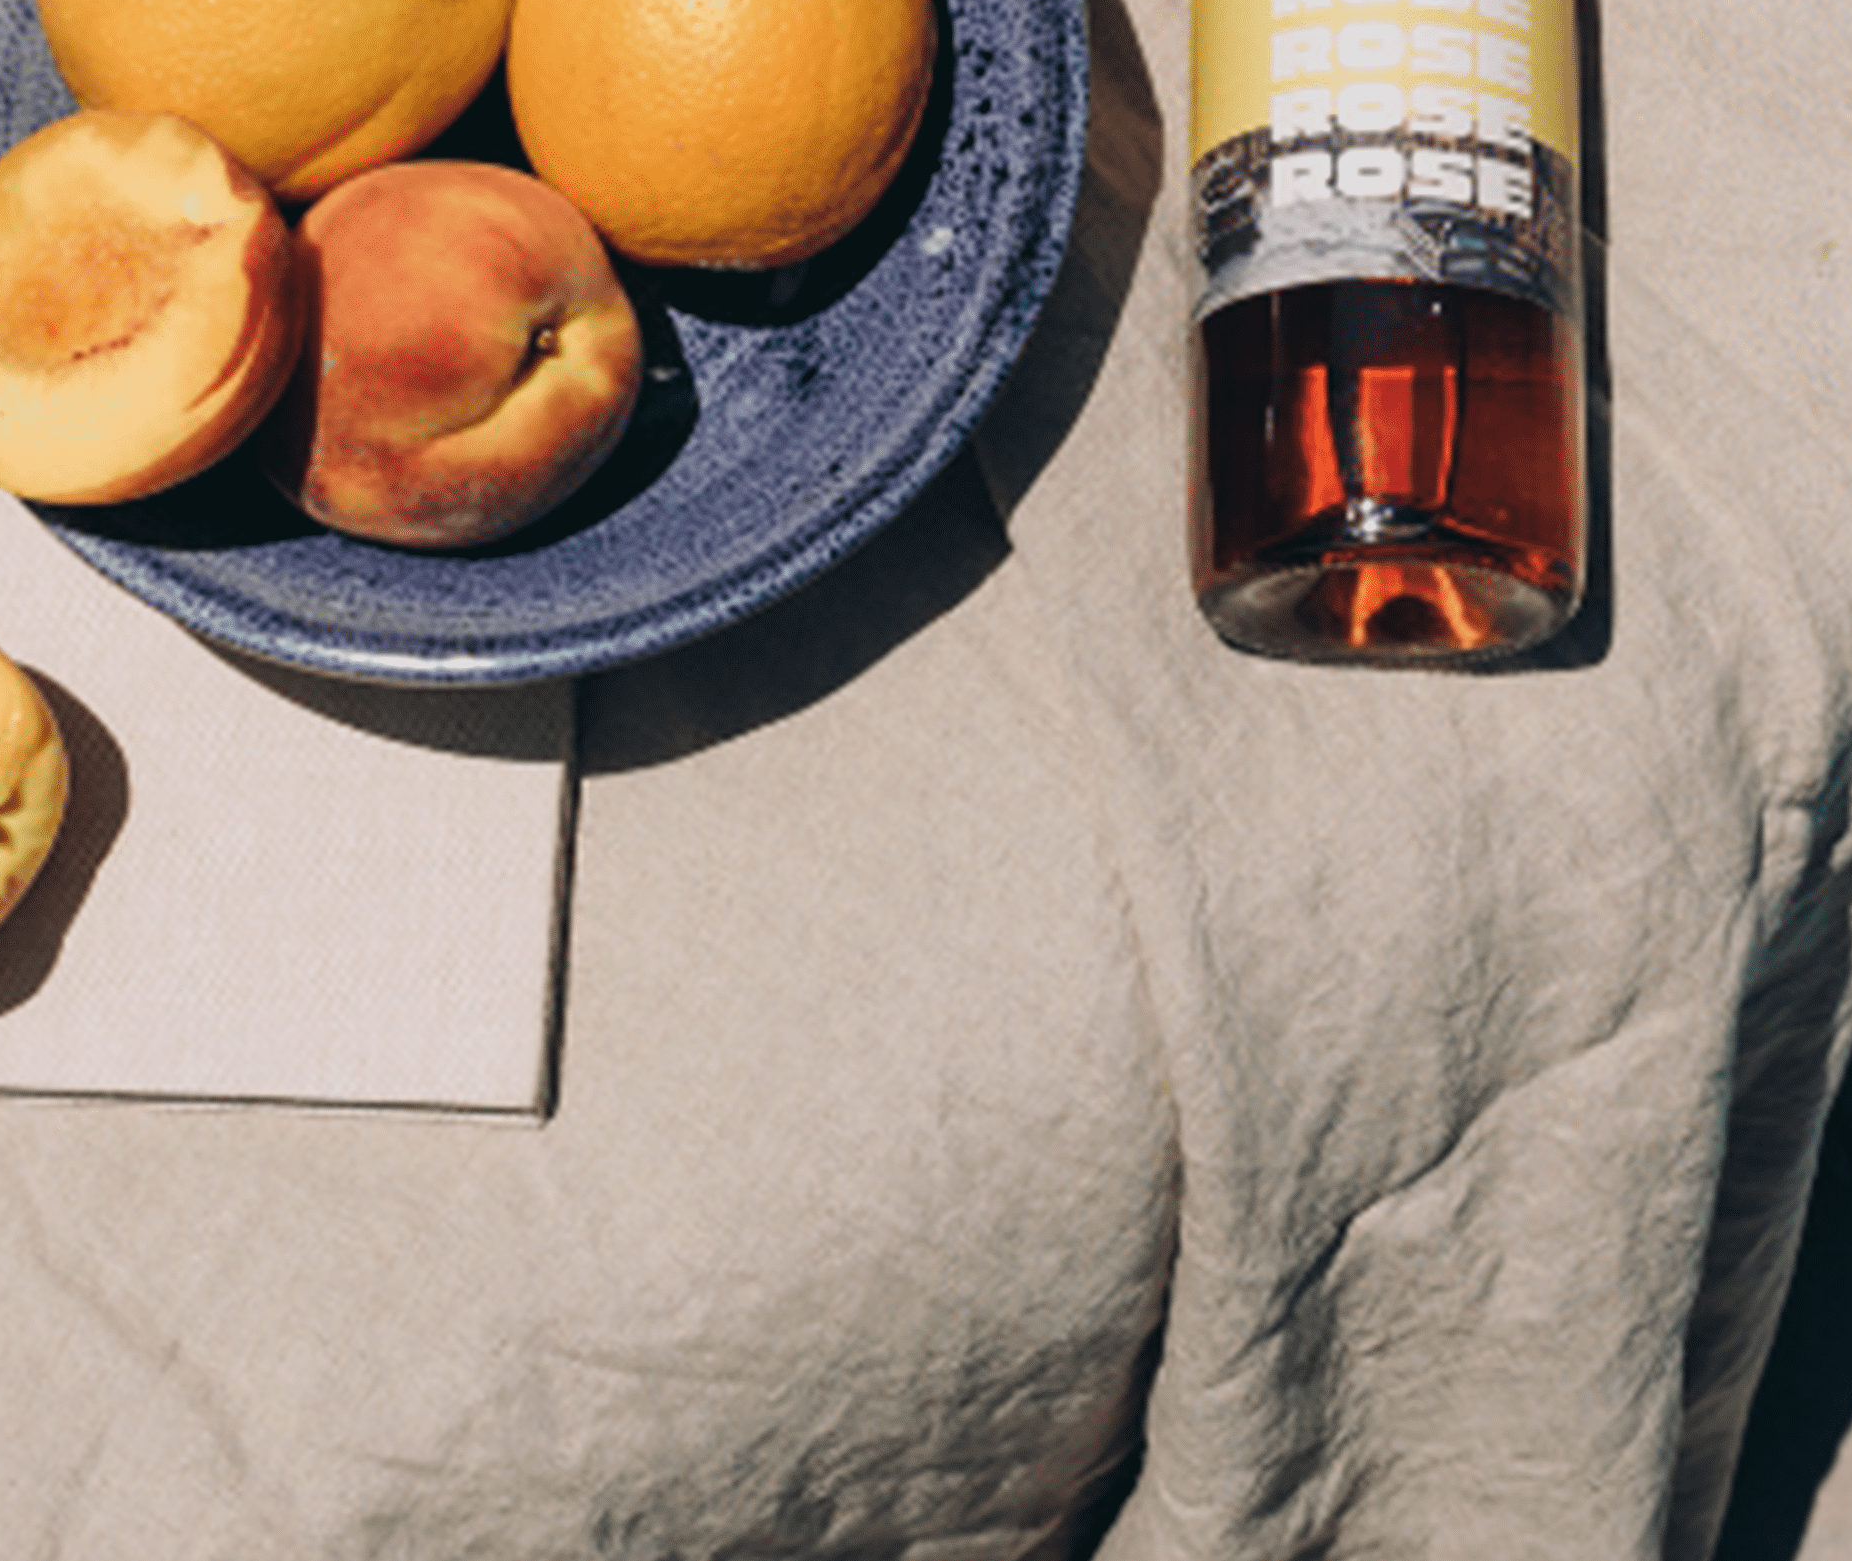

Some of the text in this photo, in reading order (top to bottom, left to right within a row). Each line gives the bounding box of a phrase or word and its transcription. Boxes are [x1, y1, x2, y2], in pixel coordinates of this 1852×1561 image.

[1271, 21, 1531, 93] ROSE
[1271, 81, 1531, 153] ROSE
[1271, 146, 1533, 219] ROSE
